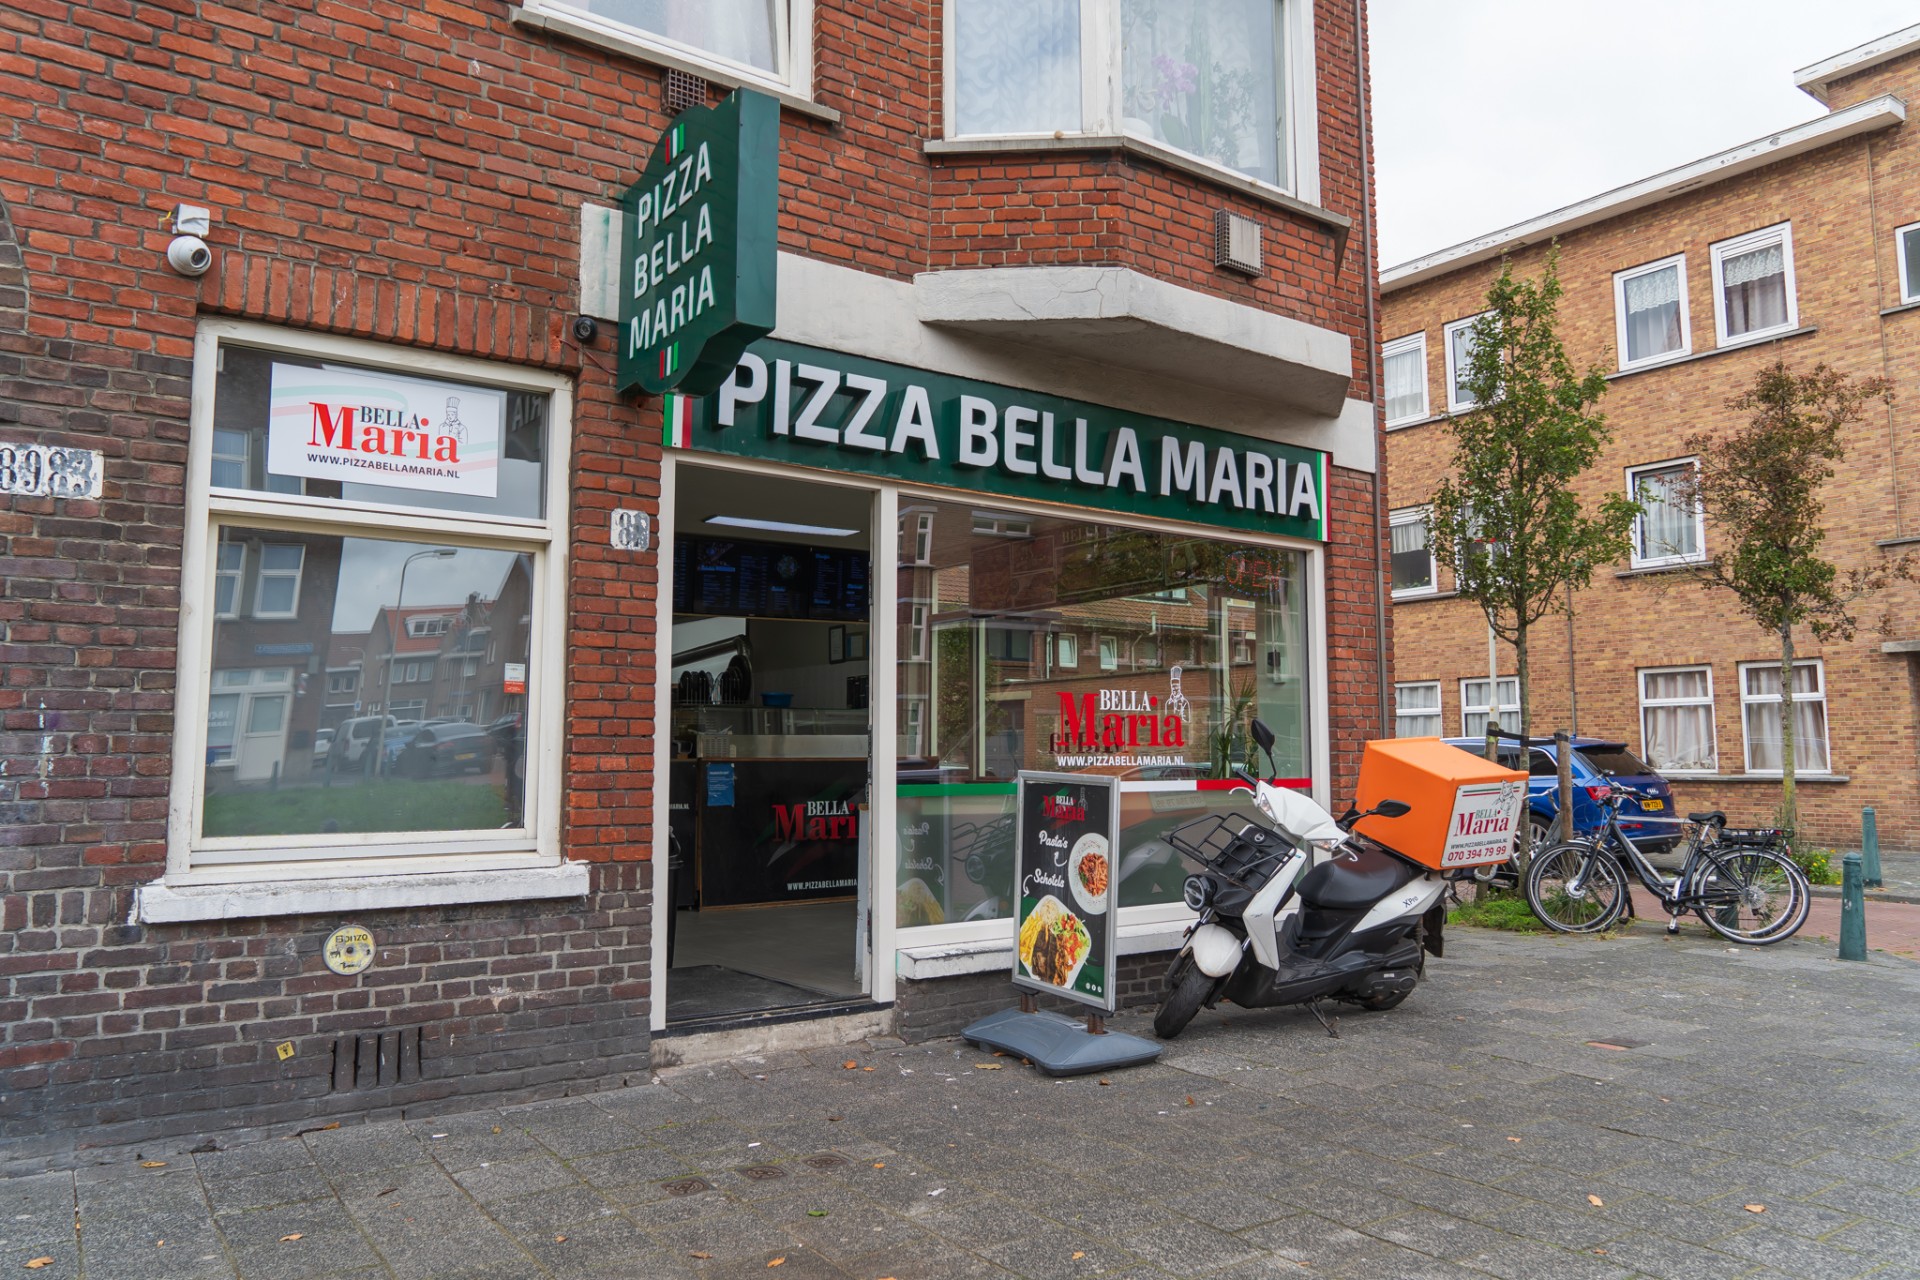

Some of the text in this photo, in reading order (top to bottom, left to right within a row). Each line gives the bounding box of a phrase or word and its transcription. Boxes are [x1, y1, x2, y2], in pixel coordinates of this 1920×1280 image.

[638, 141, 712, 240] PIZZA
[634, 202, 713, 300] BELLA
[629, 264, 716, 360] MARIA
[360, 405, 421, 430] BELLA
[306, 401, 461, 463] Maria
[716, 351, 1321, 521] PIZZA BELLA MARIA
[307, 453, 461, 479] WWW.PIZZABELLAMARIA.NL
[1226, 555, 1281, 590] OPEN
[1100, 689, 1151, 711] BELLA
[1056, 691, 1185, 747] Maria
[1057, 755, 1185, 766] WWW.PIZZABELLAMARIA.NL
[807, 800, 849, 816] BELLA
[1042, 795, 1085, 821] Maria
[1056, 795, 1074, 806] BELLA
[771, 802, 858, 842] Mari
[1453, 810, 1509, 837] Maria
[1475, 809, 1498, 820] BELLA
[1039, 830, 1068, 848] Pasta's
[1447, 845, 1507, 862] 070 394 79 99
[787, 878, 858, 891] WWW.PIZZABELLAMARIA
[1033, 868, 1065, 888] Schotels
